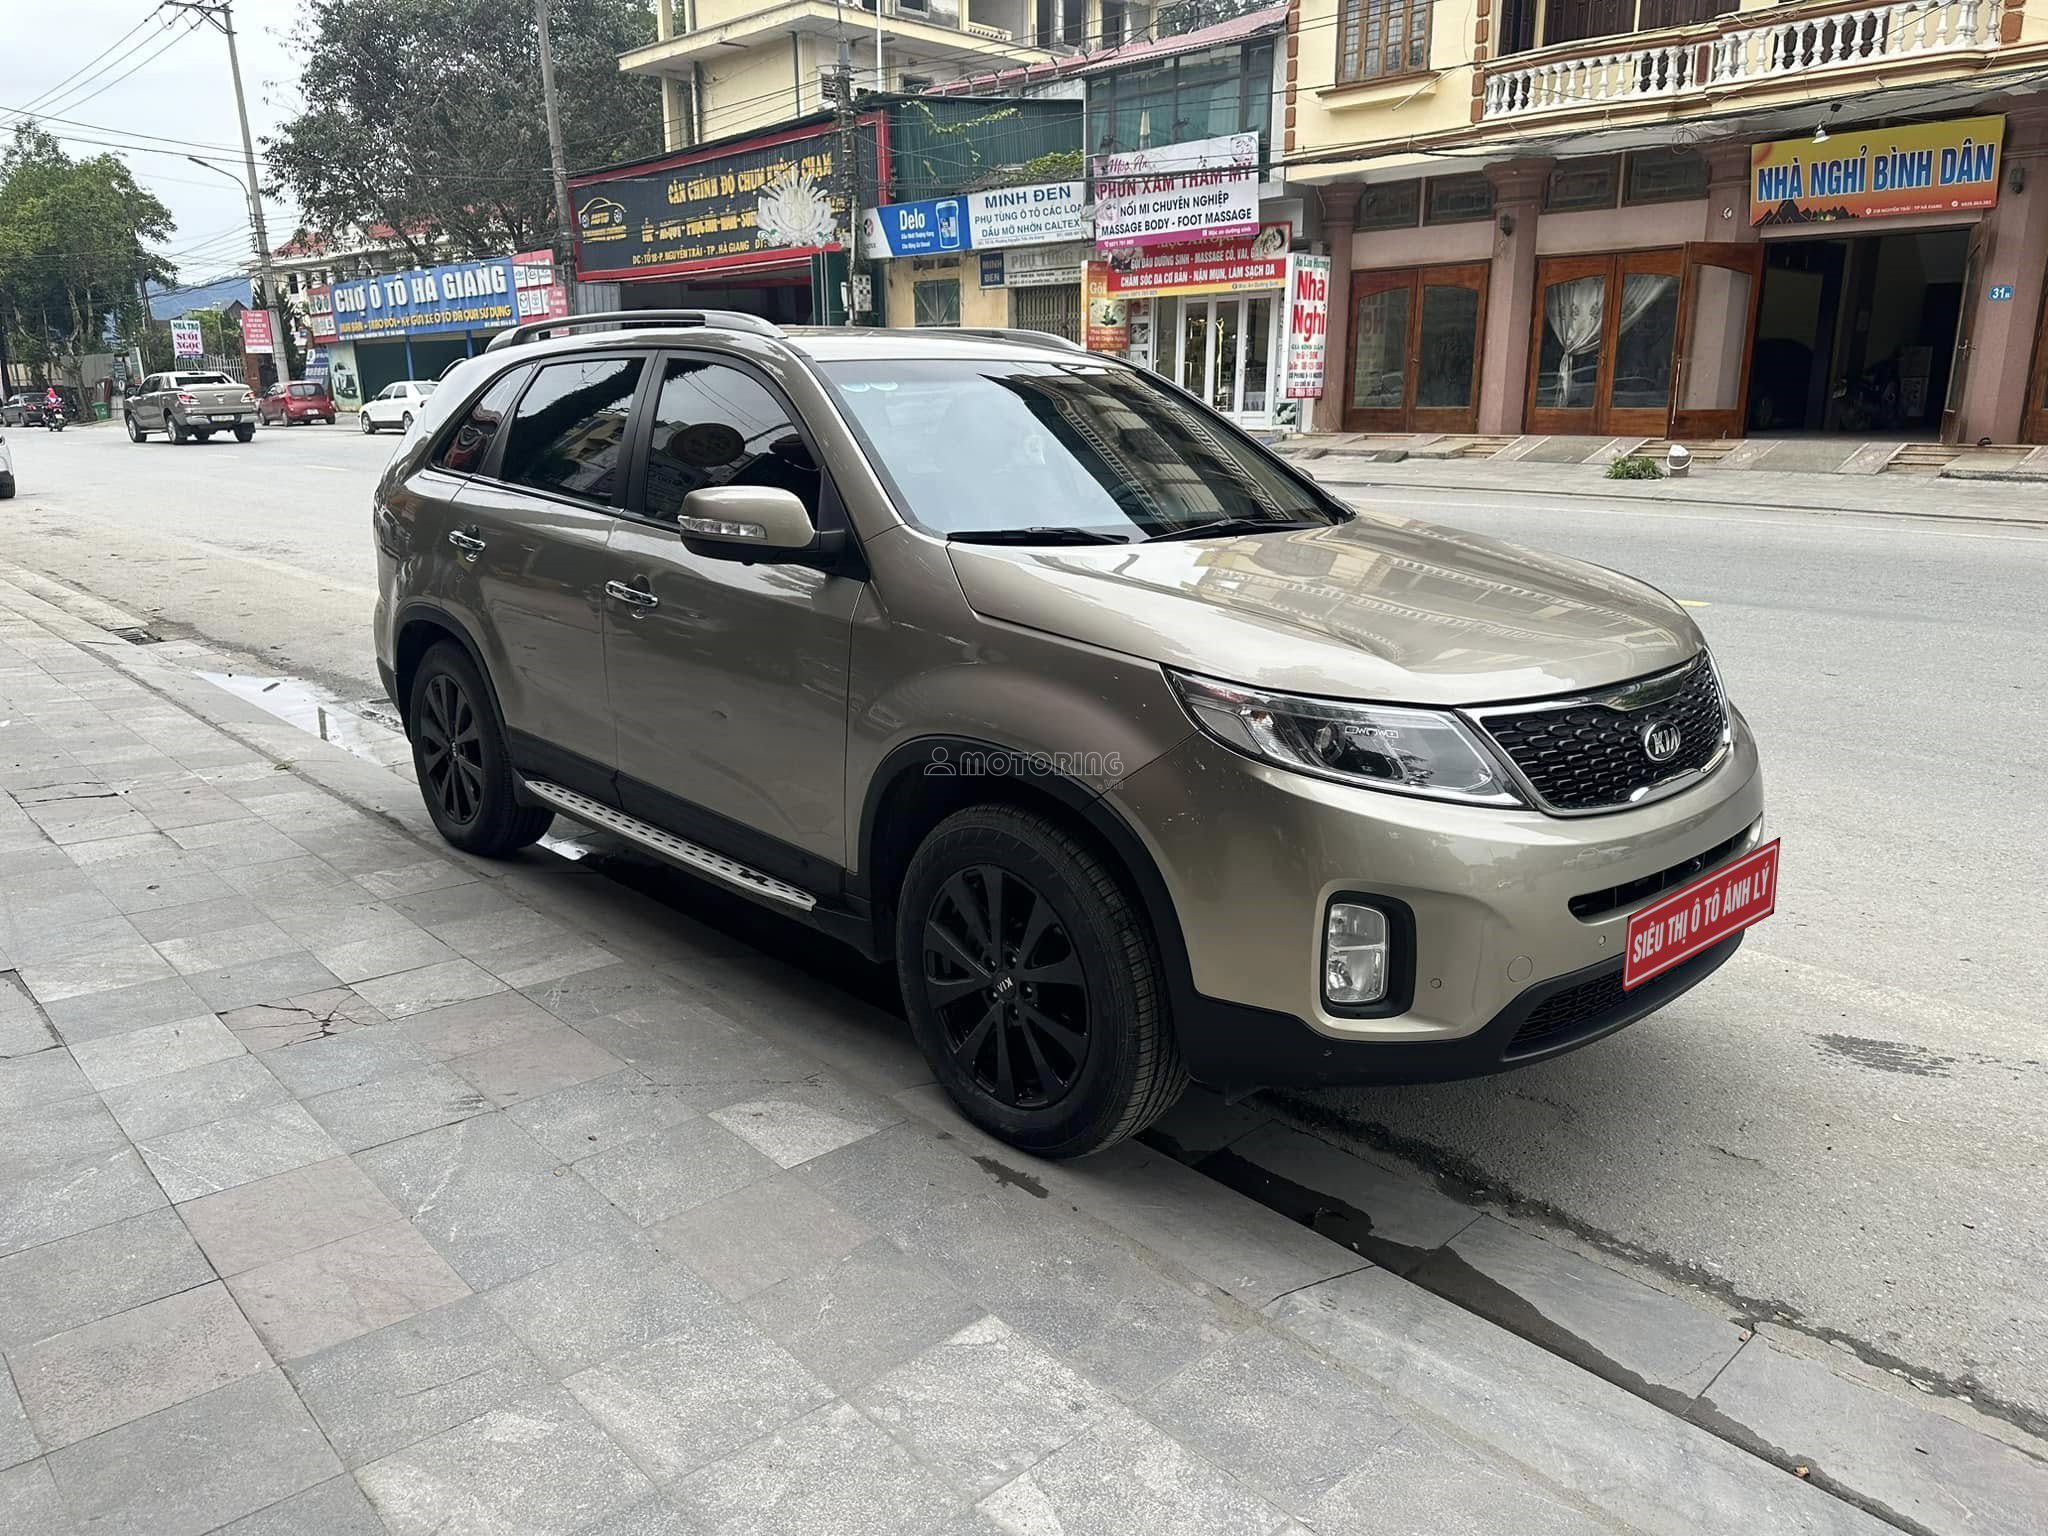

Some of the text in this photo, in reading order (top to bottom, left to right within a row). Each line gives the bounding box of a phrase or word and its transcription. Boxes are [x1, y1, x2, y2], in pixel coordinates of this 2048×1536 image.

[1758, 138, 1996, 202] NHÀ NGHỈ BÌNH DÂN
[985, 185, 1071, 209] MINH ĐEN
[1100, 179, 1136, 200] PHUN
[975, 215, 992, 225] PHỤ
[994, 211, 1018, 222] TÙNG
[1020, 208, 1027, 219] Ô
[1029, 206, 1040, 218] TÔ
[1043, 203, 1061, 216] CÁC
[1120, 190, 1230, 217] NỐI MI CHUYÊN NGHIỆP
[899, 209, 926, 231] Delo
[1045, 219, 1081, 231] CALTEX
[1101, 220, 1142, 237] MASSAGE
[1145, 218, 1170, 232] BODY
[1177, 215, 1204, 228] FOOT
[1205, 208, 1253, 224] MASSAGE
[1175, 253, 1190, 265] SINH
[1194, 250, 1224, 263] MASSAGE
[1140, 273, 1153, 286] SÓC
[1153, 273, 1163, 284] DA
[1163, 271, 1174, 284] CƠ
[1244, 265, 1263, 281] SẠCH
[1265, 264, 1276, 276] DA
[1297, 270, 1325, 301] Nhà
[334, 266, 507, 317] CHỢ Ô TÔ HÀ GIANG
[1292, 304, 1327, 342] Nghỉ
[1652, 733, 1679, 756] KIA
[1632, 861, 1771, 964] SIÊU THỊ Ô TÔ ÁNH LÝ
